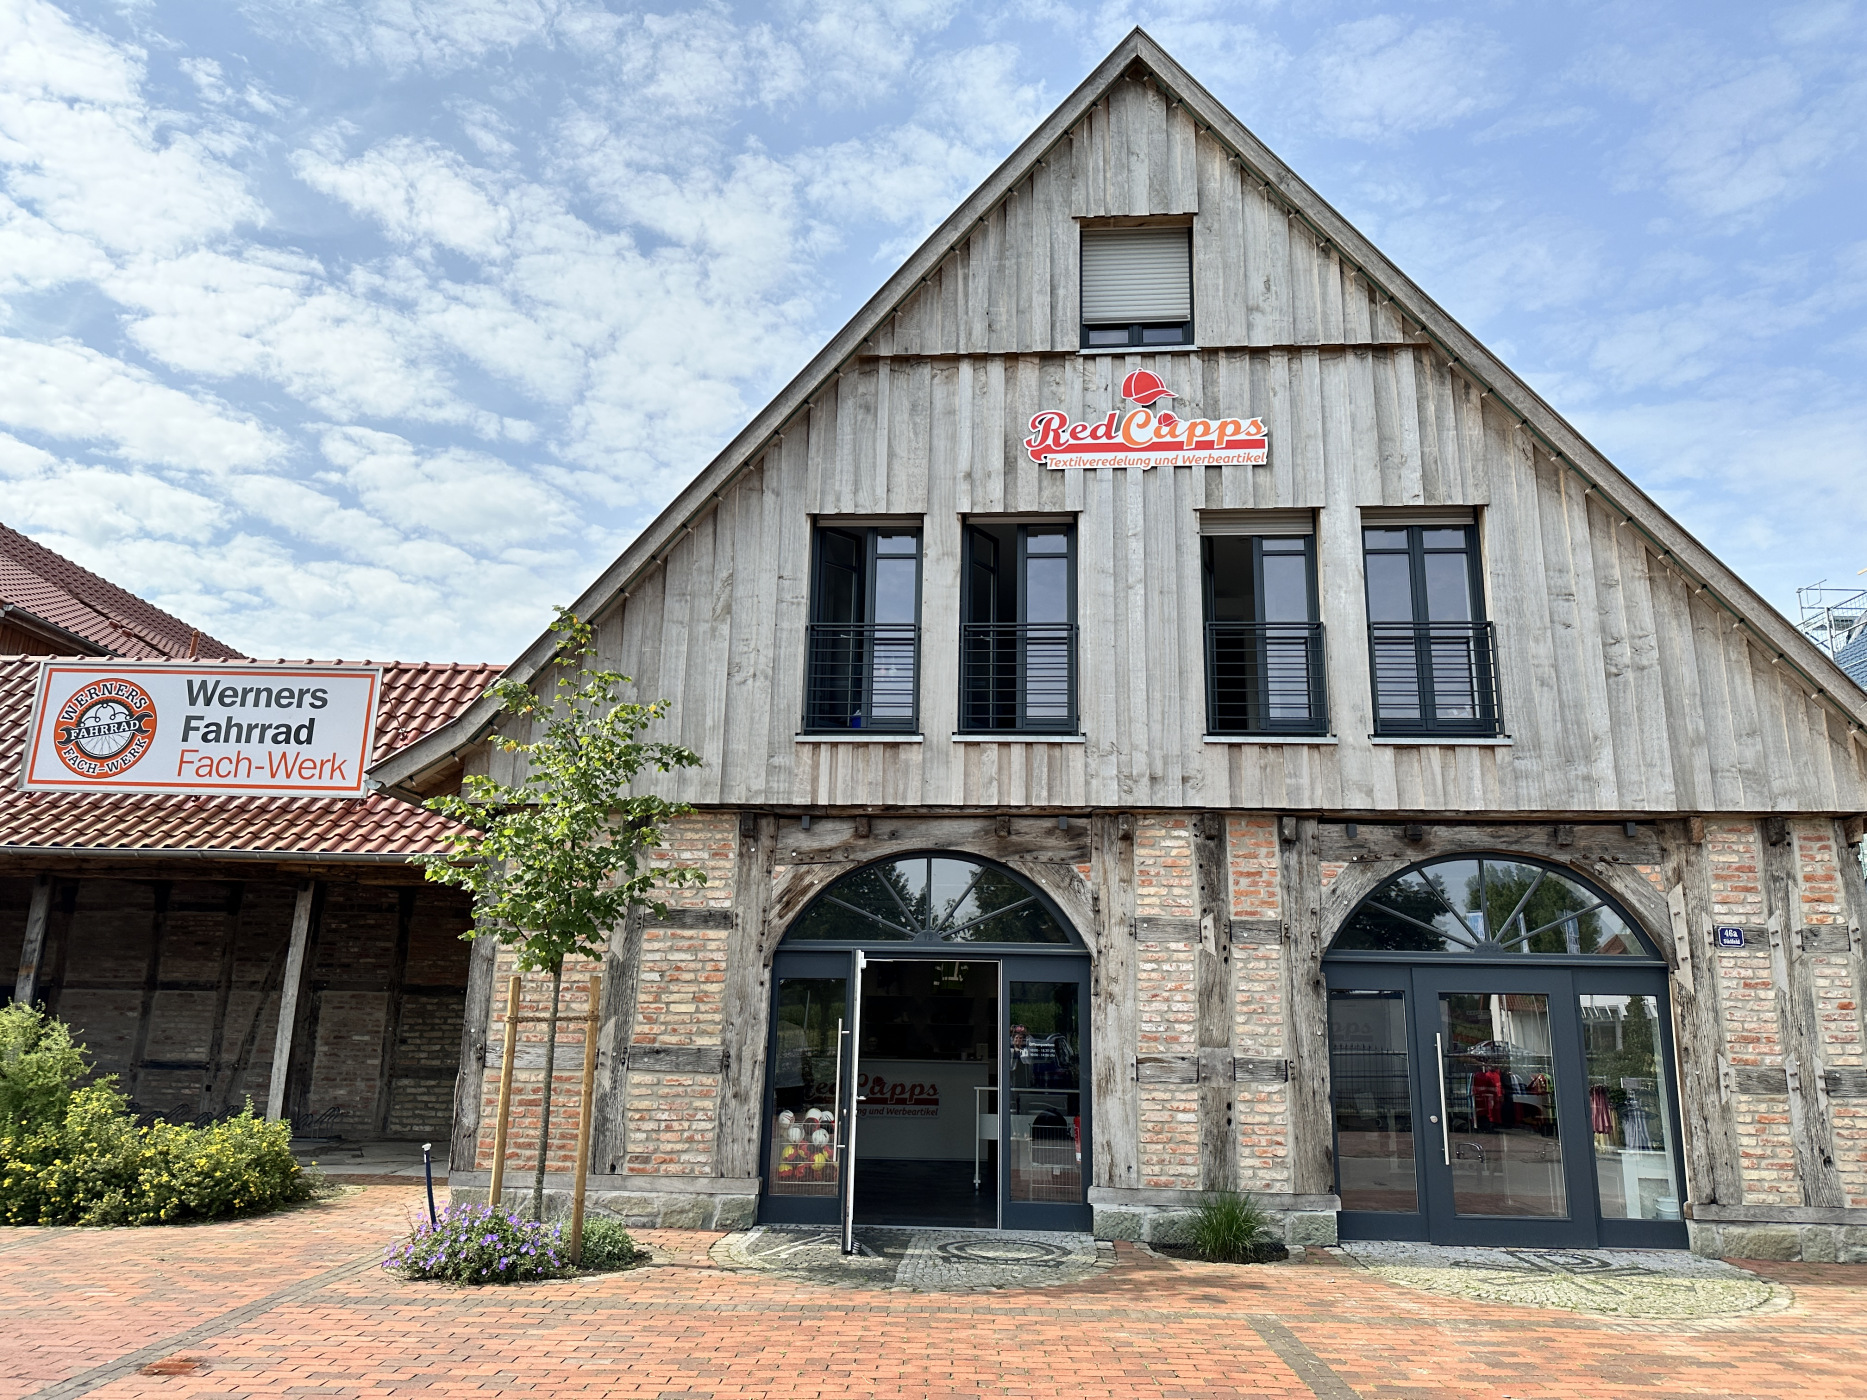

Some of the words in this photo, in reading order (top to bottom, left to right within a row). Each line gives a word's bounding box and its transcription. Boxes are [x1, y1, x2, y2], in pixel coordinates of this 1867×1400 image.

[1048, 456, 1151, 469] Textilveredelung
[1154, 455, 1178, 466] und
[1182, 452, 1266, 465] Werbeartikel
[61, 683, 148, 722] WERNERS
[186, 679, 329, 710] Werners
[70, 720, 139, 740] FAHRRAD
[181, 715, 315, 746] Fahrrad
[63, 738, 147, 774] FACH-WERK
[177, 748, 348, 781] Fach-Werk
[1724, 929, 1738, 938] 46a
[869, 1107, 884, 1115] und
[886, 1107, 938, 1116] Werbeartikel
